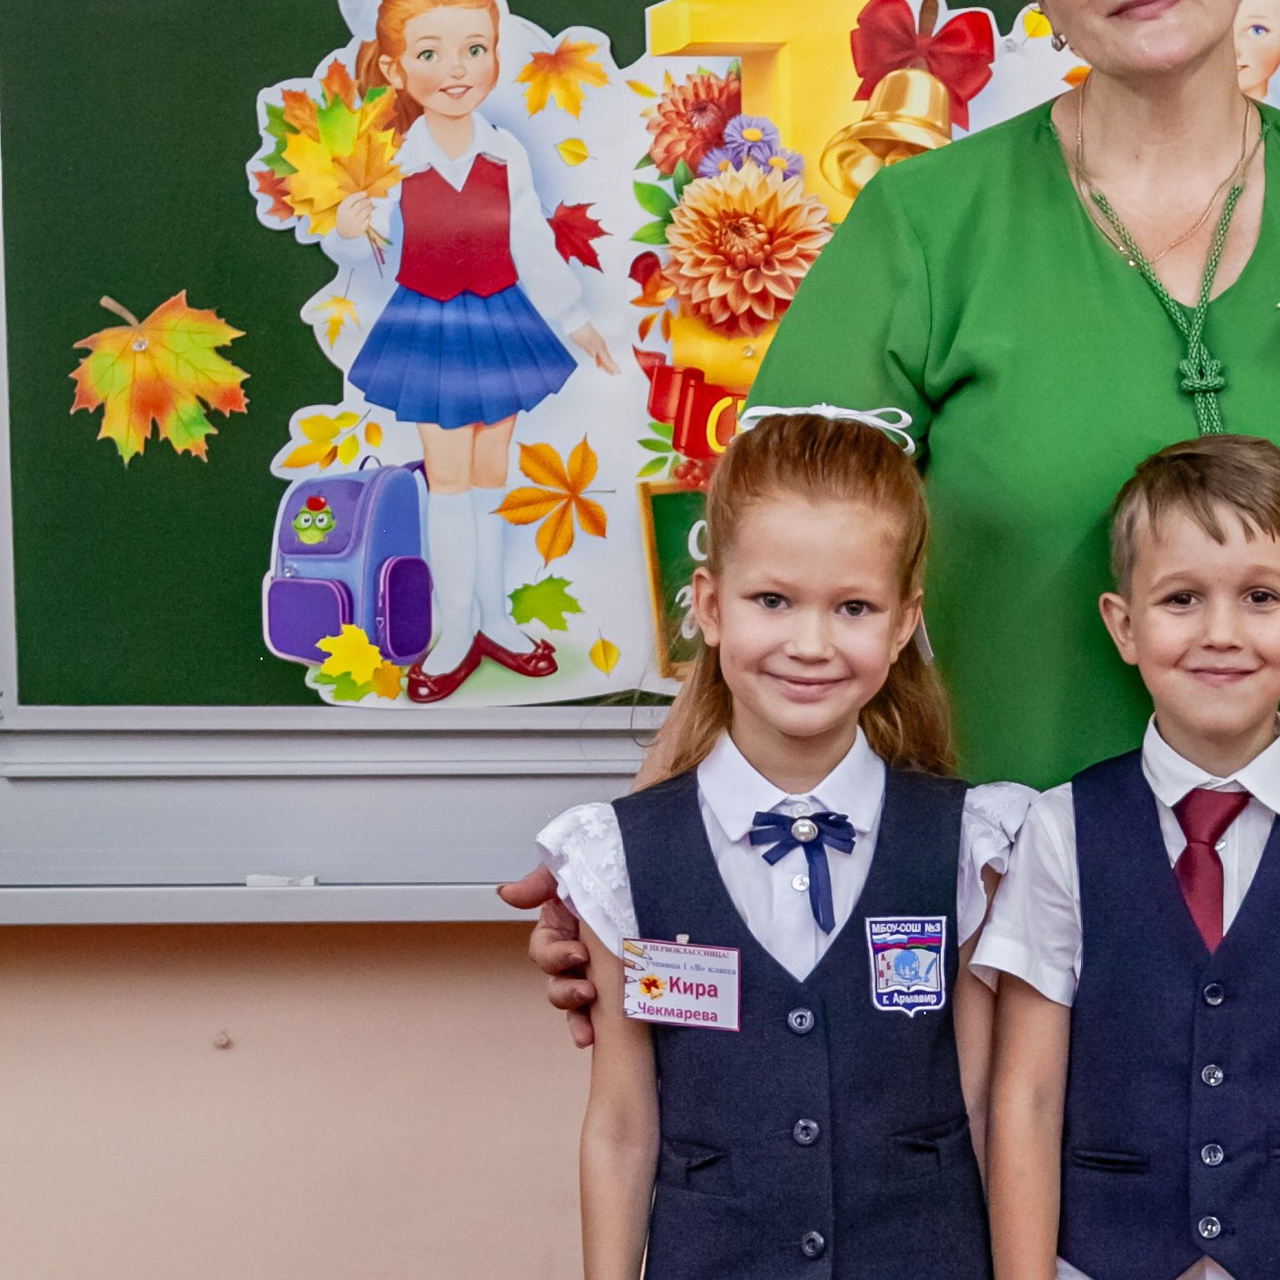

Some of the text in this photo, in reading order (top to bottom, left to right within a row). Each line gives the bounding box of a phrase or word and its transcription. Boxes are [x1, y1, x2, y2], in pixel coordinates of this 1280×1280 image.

[668, 975, 718, 1000] Кира
[892, 992, 937, 1005] Армавир
[637, 1001, 718, 1023] Чекмарева
